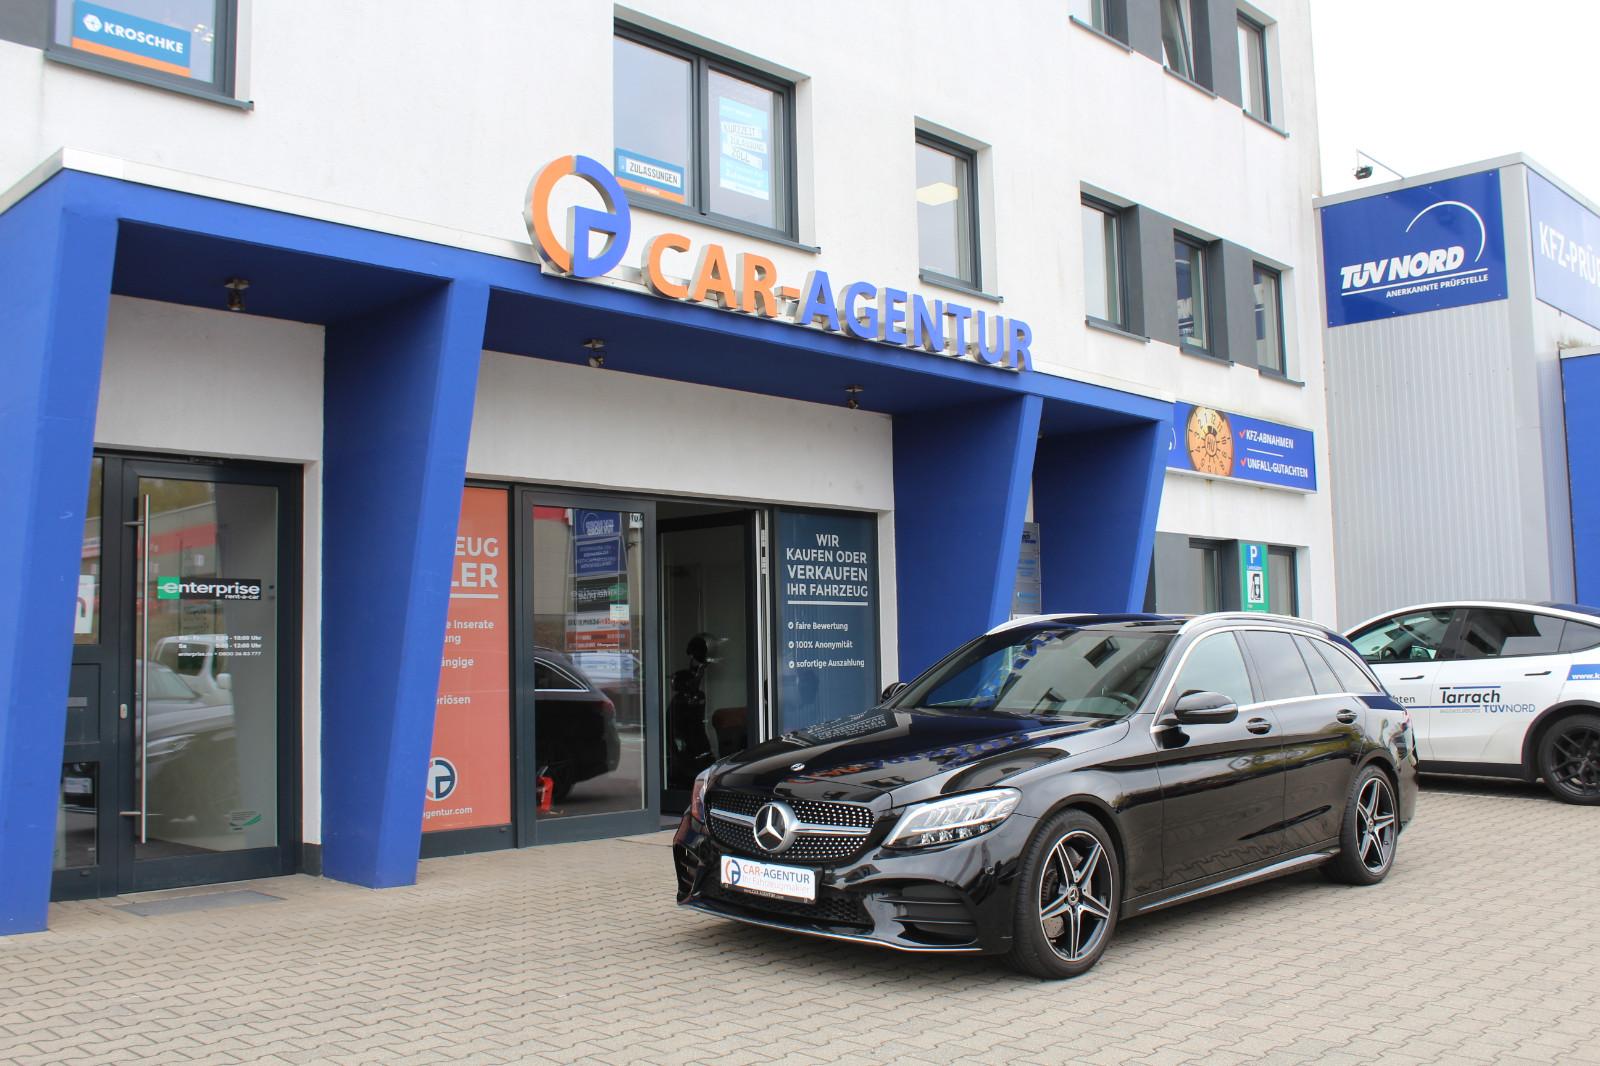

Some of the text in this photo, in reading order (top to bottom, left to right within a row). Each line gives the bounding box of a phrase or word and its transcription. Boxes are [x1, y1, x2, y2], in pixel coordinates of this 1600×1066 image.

[104, 21, 184, 54] KROSCHKE
[629, 161, 678, 185] ZULASSUNGEN
[1387, 245, 1465, 281] NORD
[1386, 274, 1489, 299] ANERKANNTE PRÜFSTELLE
[641, 233, 1034, 372] CAR-AGENTUR
[1246, 429, 1294, 449] KFZ-ABNAHMEN
[1247, 458, 1309, 479] UNFALL-GUTACHTEN
[816, 533, 840, 548] WIR
[786, 548, 867, 564] KAUFEN ODER
[1249, 545, 1258, 564] P
[787, 564, 868, 582] VERKAUFEN
[162, 581, 260, 597] enterprise
[787, 583, 868, 597] IHR FAHRZEUG
[454, 619, 495, 629] Inserate
[796, 621, 849, 632] faire Bewertung
[795, 640, 853, 650] 100% Anonymität
[796, 659, 865, 669] sofortige Auszahlung
[423, 807, 473, 820] gentur.com
[743, 864, 810, 885] CAR-AGENTUR
